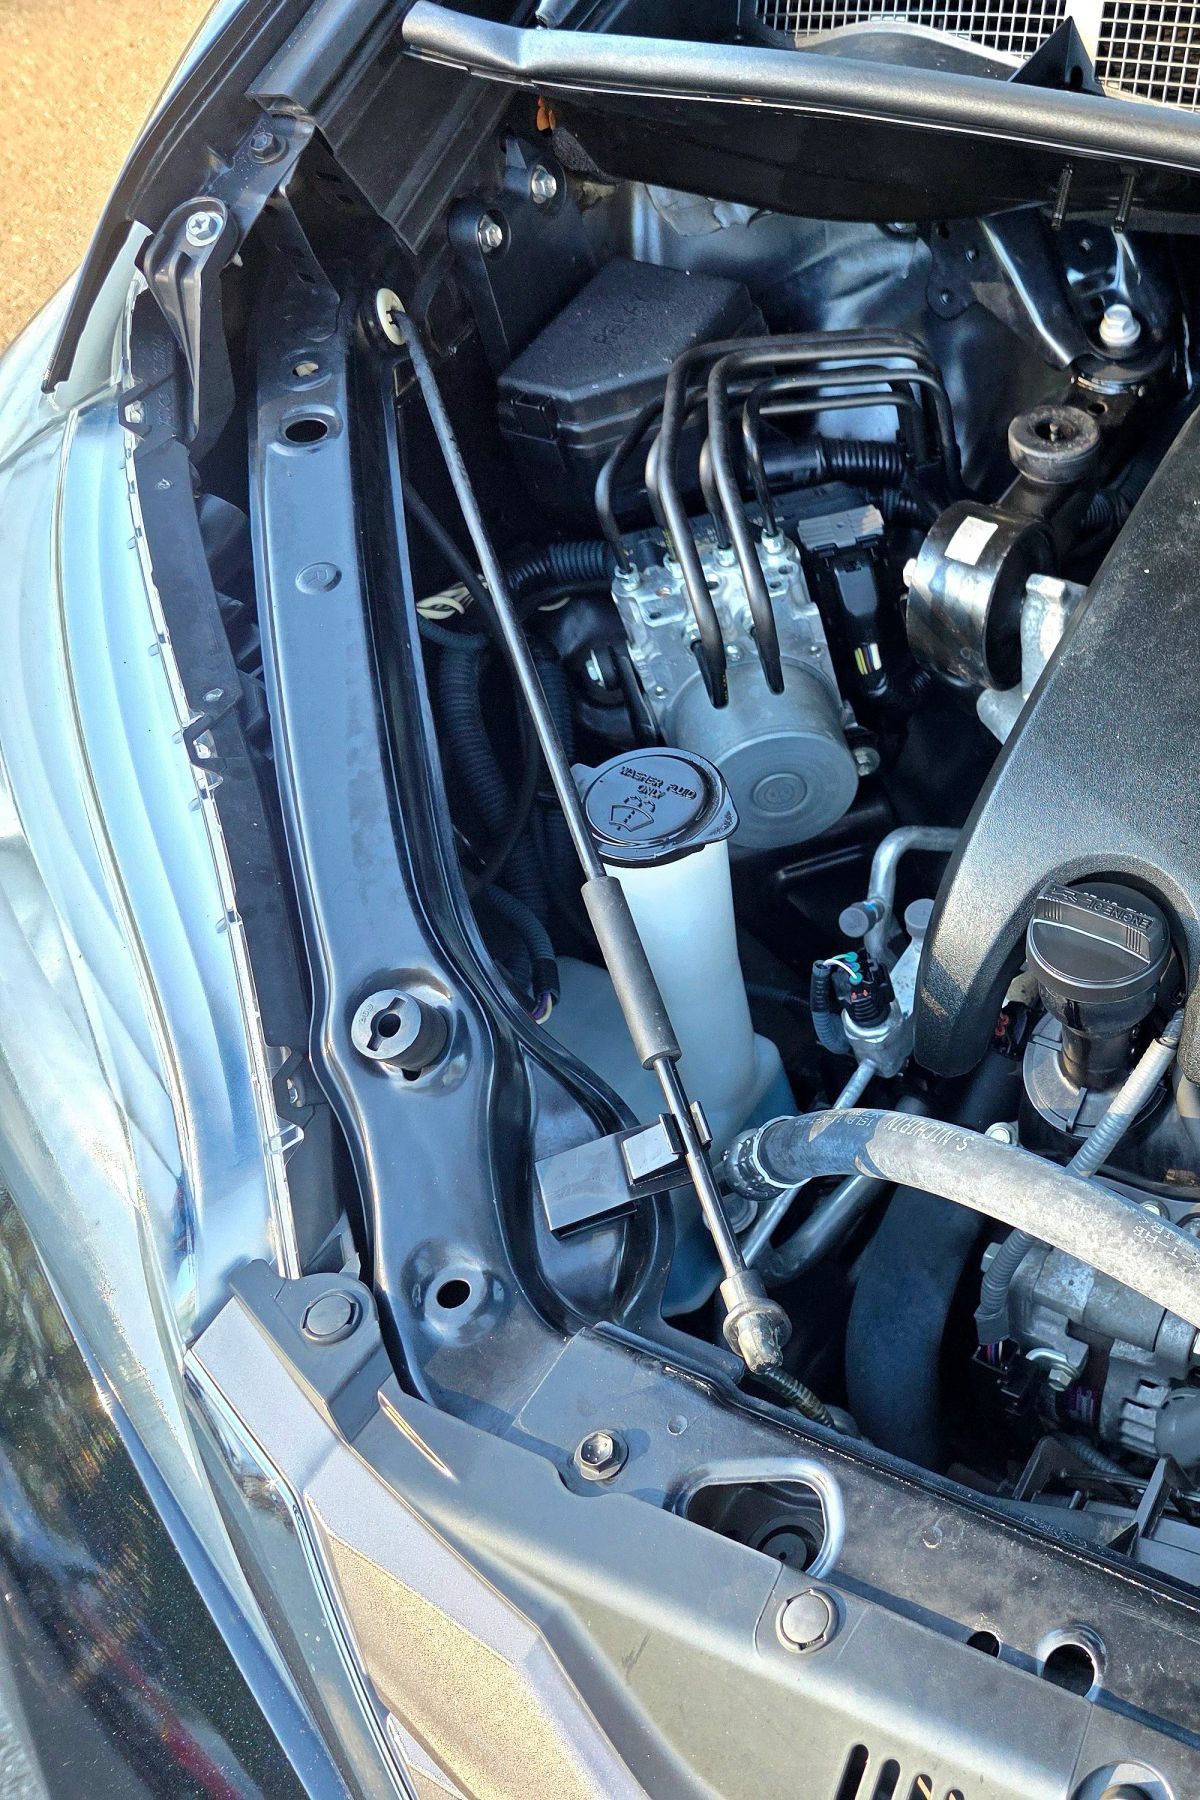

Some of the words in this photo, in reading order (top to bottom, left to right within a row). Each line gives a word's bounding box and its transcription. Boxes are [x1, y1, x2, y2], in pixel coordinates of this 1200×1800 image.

[619, 766, 664, 788] WASHER
[666, 783, 698, 800] FLUID
[637, 784, 666, 799] ONLY
[1103, 904, 1154, 930] ENGINE
